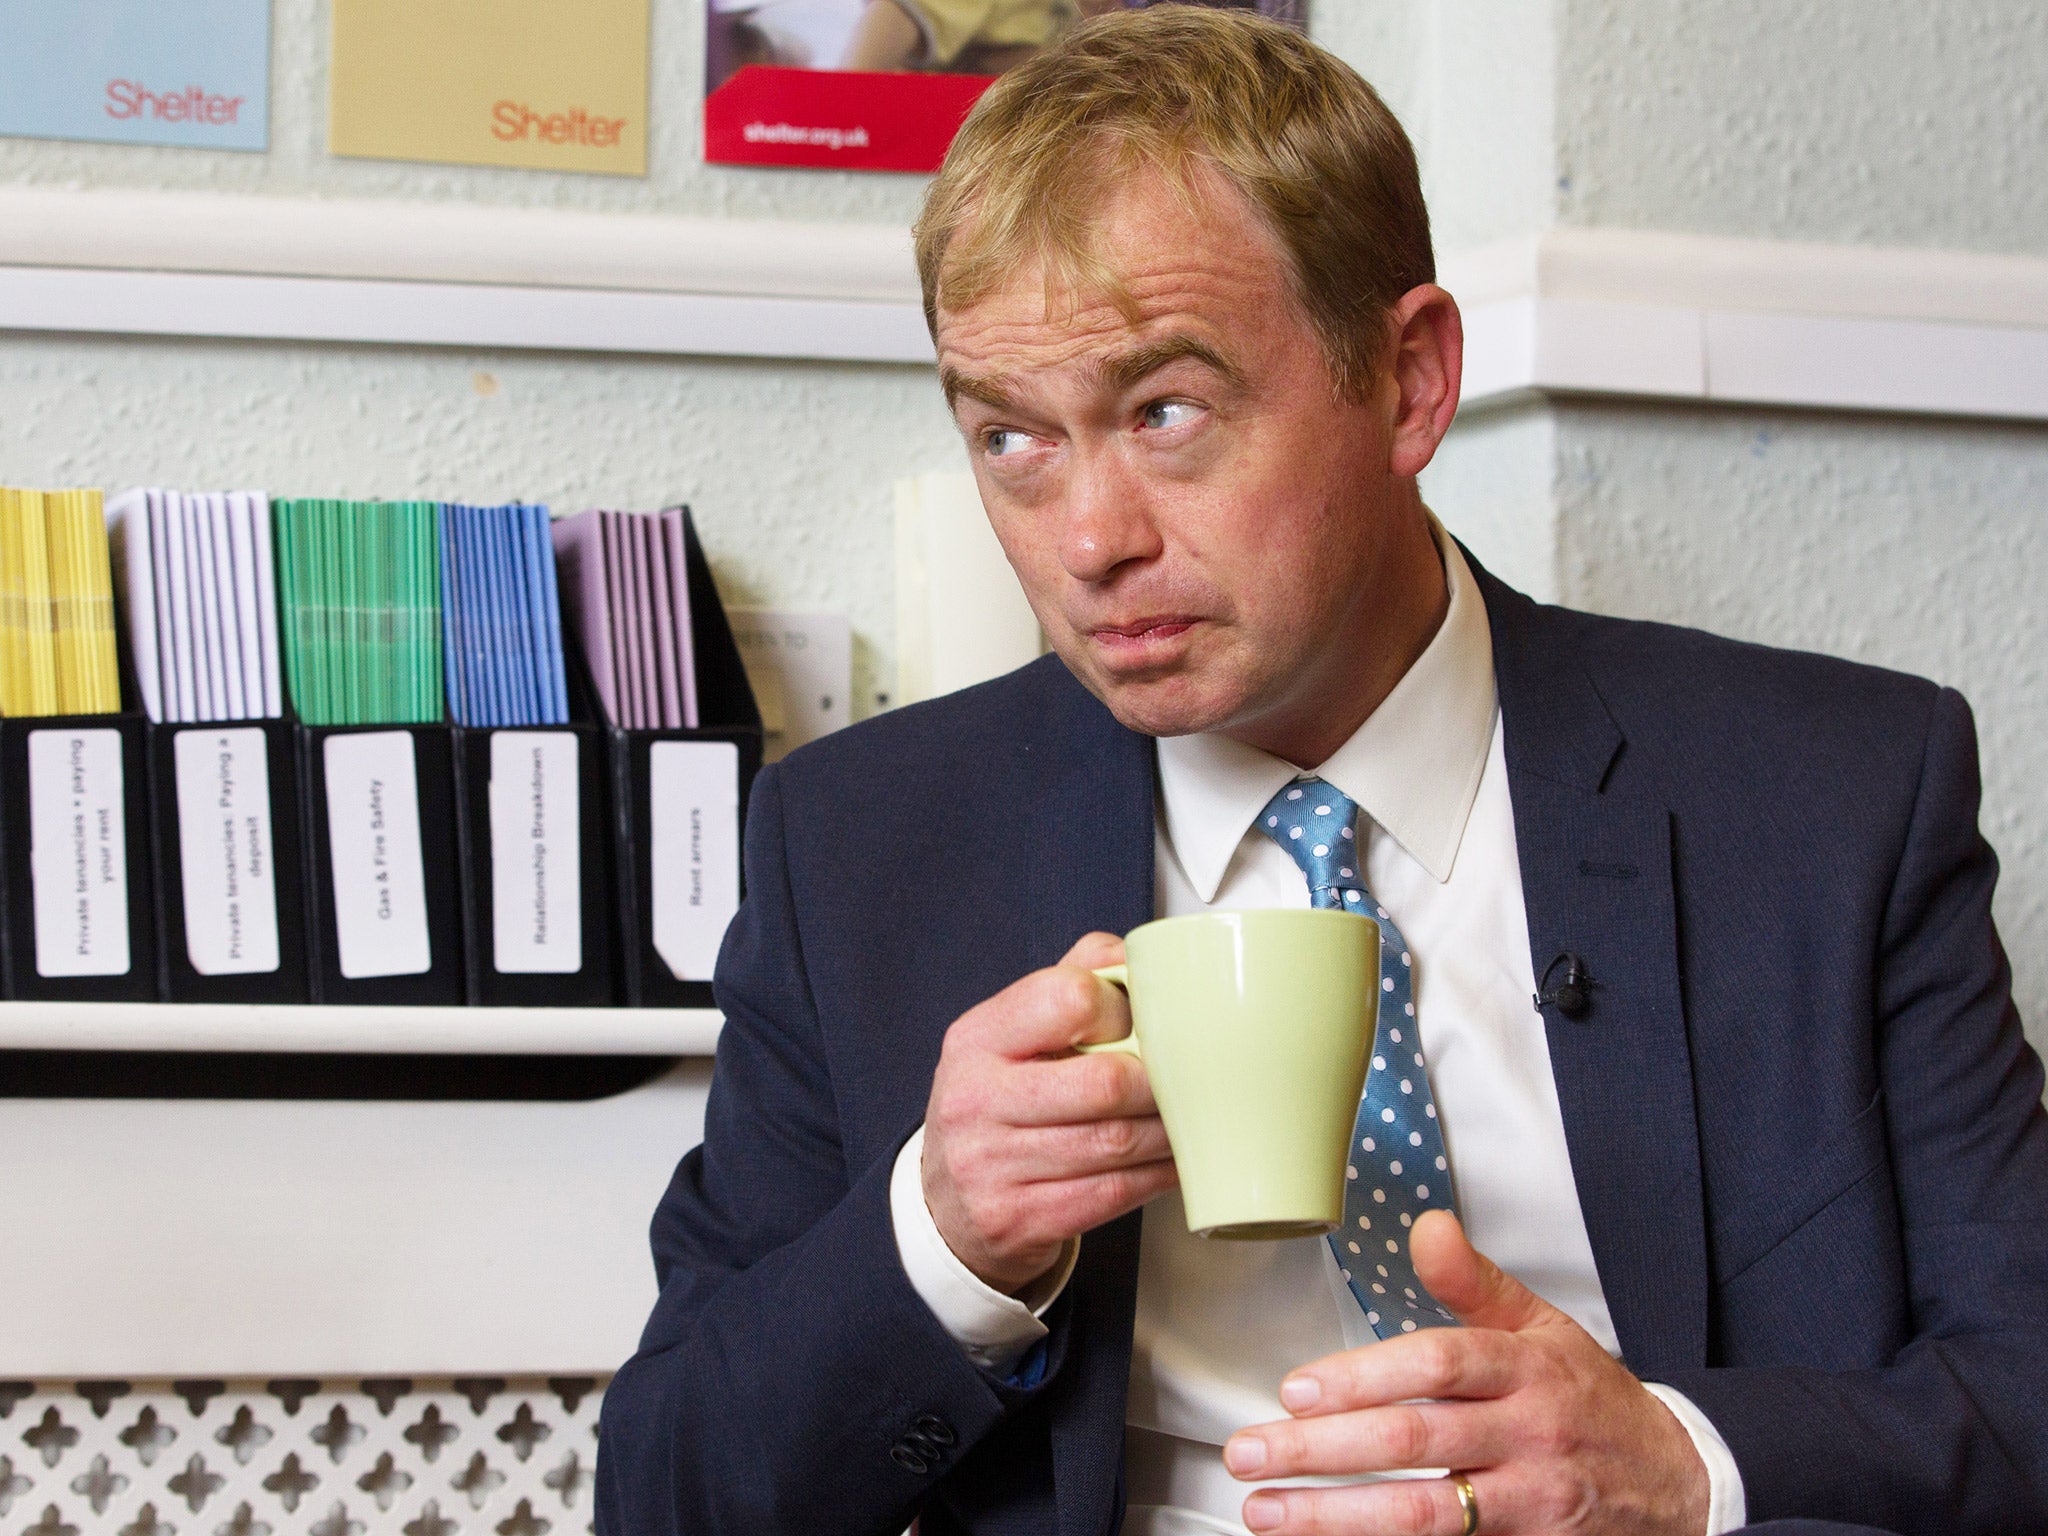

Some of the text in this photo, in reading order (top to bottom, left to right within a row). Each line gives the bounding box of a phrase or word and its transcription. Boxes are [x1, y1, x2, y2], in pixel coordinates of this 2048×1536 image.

[104, 78, 246, 125] Shelter
[490, 99, 628, 148] Shelter
[743, 121, 870, 150] shelter.org.uk
[69, 738, 86, 794] paying
[220, 738, 229, 747] a
[218, 752, 233, 808] Paying
[72, 814, 87, 893] tenancies
[96, 808, 115, 884] your rent
[246, 816, 262, 878] deposit
[368, 779, 392, 920] Gas & Fire Safety
[530, 747, 548, 945] Relationship Breakdown
[689, 808, 702, 906] Rent arrears
[76, 898, 90, 956] Private
[227, 903, 241, 960] Private
